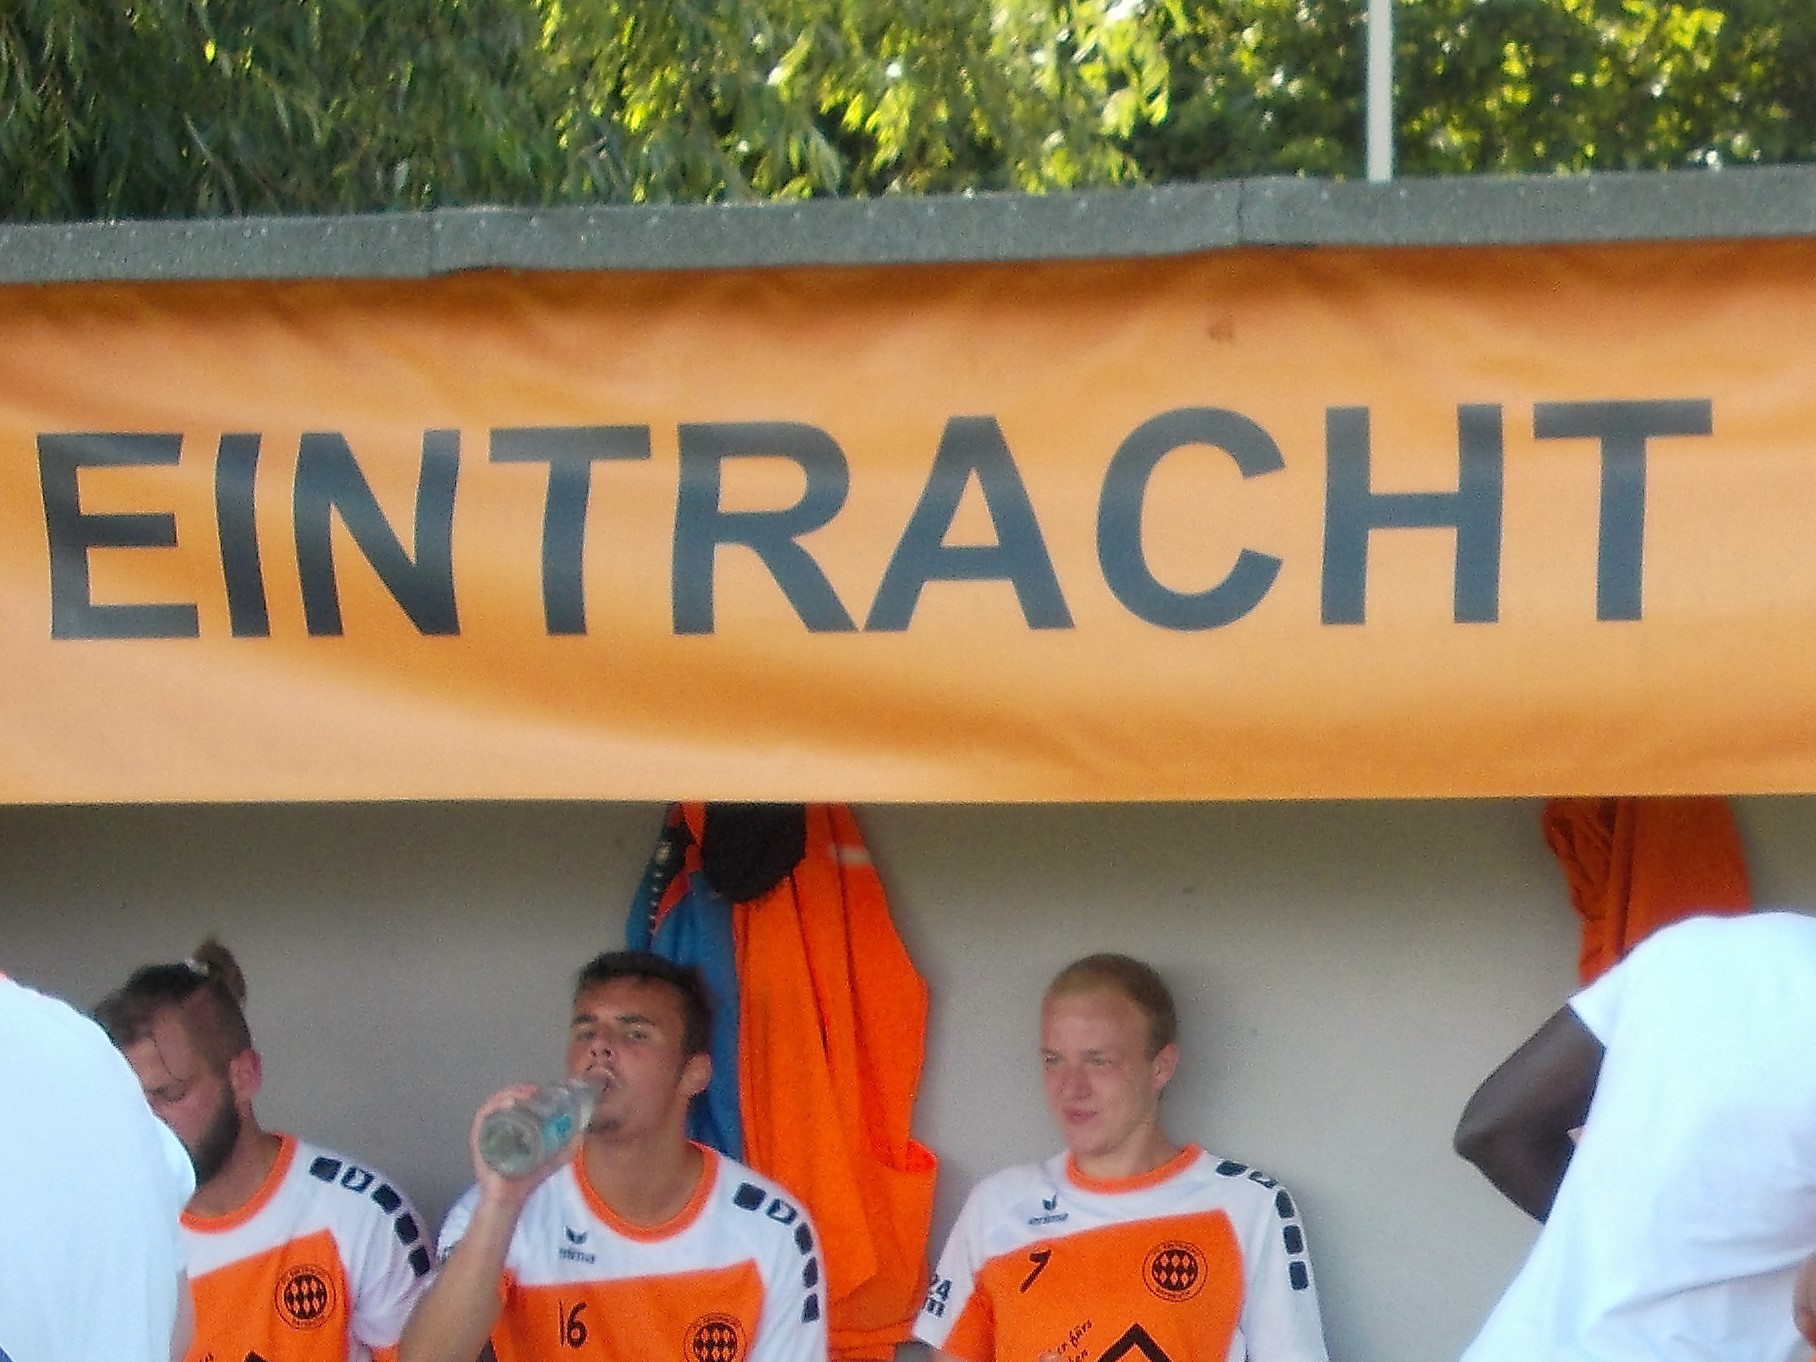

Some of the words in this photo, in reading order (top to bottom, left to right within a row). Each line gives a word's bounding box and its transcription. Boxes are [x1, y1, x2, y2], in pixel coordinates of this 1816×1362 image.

[36, 398, 1713, 641] EINTRACHT
[1020, 1250, 1051, 1293] 7
[558, 1300, 588, 1348] 16
